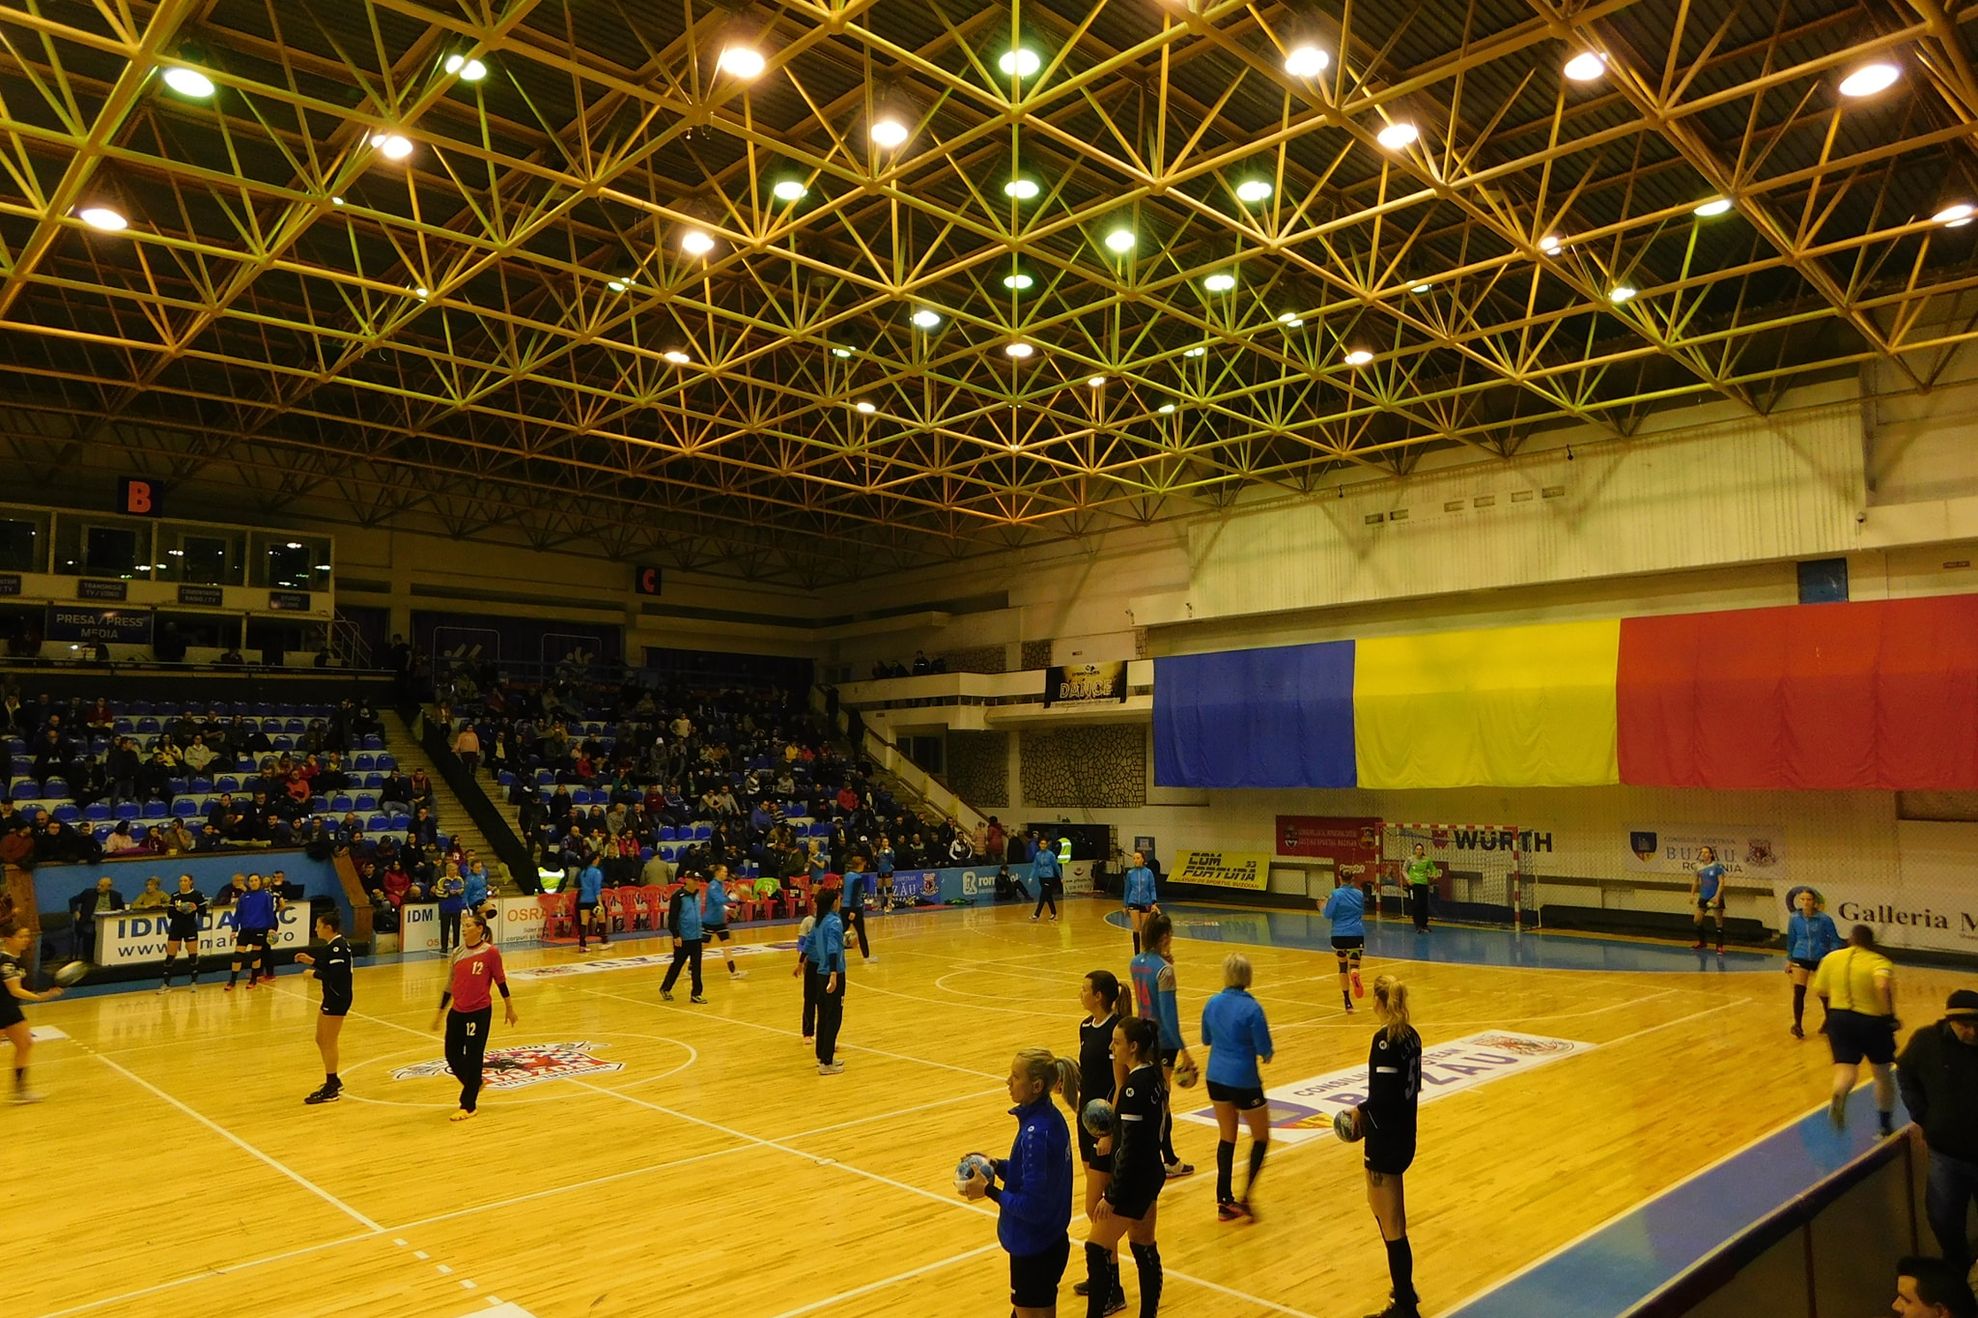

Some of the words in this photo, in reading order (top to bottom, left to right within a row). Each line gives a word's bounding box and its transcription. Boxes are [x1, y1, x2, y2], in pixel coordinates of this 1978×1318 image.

[128, 481, 151, 513] B
[642, 568, 656, 593] C
[56, 613, 95, 625] PRESA
[106, 615, 145, 628] PRESS
[1059, 678, 1114, 699] DANCE
[1454, 830, 1553, 853] WÜRTH
[407, 909, 434, 923] IDM
[1837, 901, 1949, 930] Galleria
[471, 961, 484, 975] 12
[466, 1022, 476, 1037] 12
